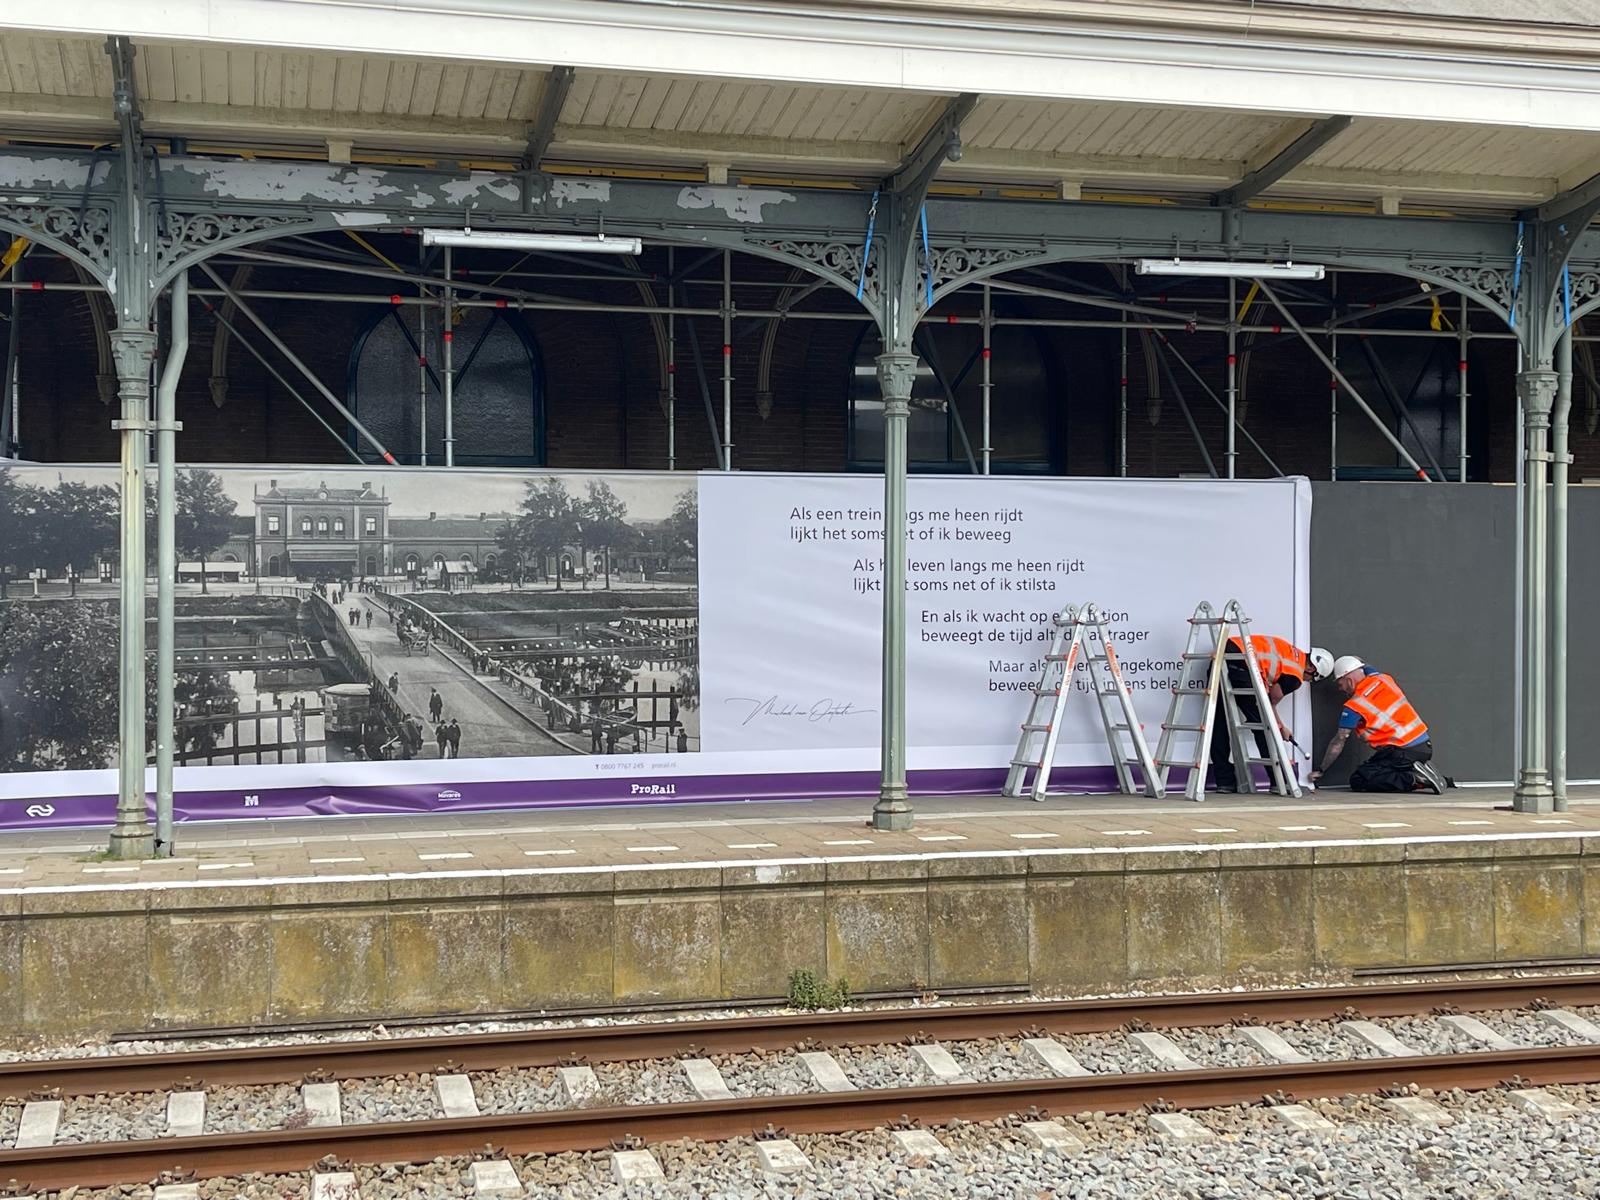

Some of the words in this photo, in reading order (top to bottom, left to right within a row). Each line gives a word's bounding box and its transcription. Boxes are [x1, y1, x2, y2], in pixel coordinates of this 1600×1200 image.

[790, 507, 811, 521] Als
[816, 510, 842, 521] een
[847, 507, 882, 521] trein
[928, 511, 950, 522] me
[955, 507, 989, 522] heen
[994, 507, 1024, 525] rijdt
[790, 526, 818, 544] lijkt
[823, 527, 847, 541] het
[850, 530, 886, 541] soms
[919, 527, 935, 541] of
[938, 527, 951, 541] ik
[955, 528, 1011, 545] beweeg
[853, 558, 875, 572] Als
[908, 558, 945, 572] leven
[950, 558, 987, 576] langs
[991, 562, 1012, 573] me
[1017, 559, 1051, 573] heen
[1056, 559, 1086, 576] rijdt
[853, 577, 880, 595] lijkt
[913, 580, 948, 592] soms
[952, 580, 976, 592] net
[980, 578, 996, 592] of
[1000, 578, 1012, 592] ik
[1016, 578, 1056, 592] stilsta
[921, 610, 938, 623] En
[943, 609, 962, 623] als
[966, 609, 979, 623] ik
[982, 609, 1025, 623] wacht
[1029, 612, 1048, 626] op
[921, 629, 983, 646] beweegt
[987, 628, 1006, 642] de
[1009, 628, 1033, 645] tijd
[1036, 628, 1072, 642] altd
[1107, 629, 1150, 645] trager
[989, 660, 1025, 673] Maar
[1029, 658, 1047, 672] als
[1103, 658, 1192, 674] angekome
[988, 678, 1042, 692] bewee
[1103, 678, 1147, 691] inens
[1150, 676, 1204, 690] belaen
[630, 783, 676, 795] ProRail
